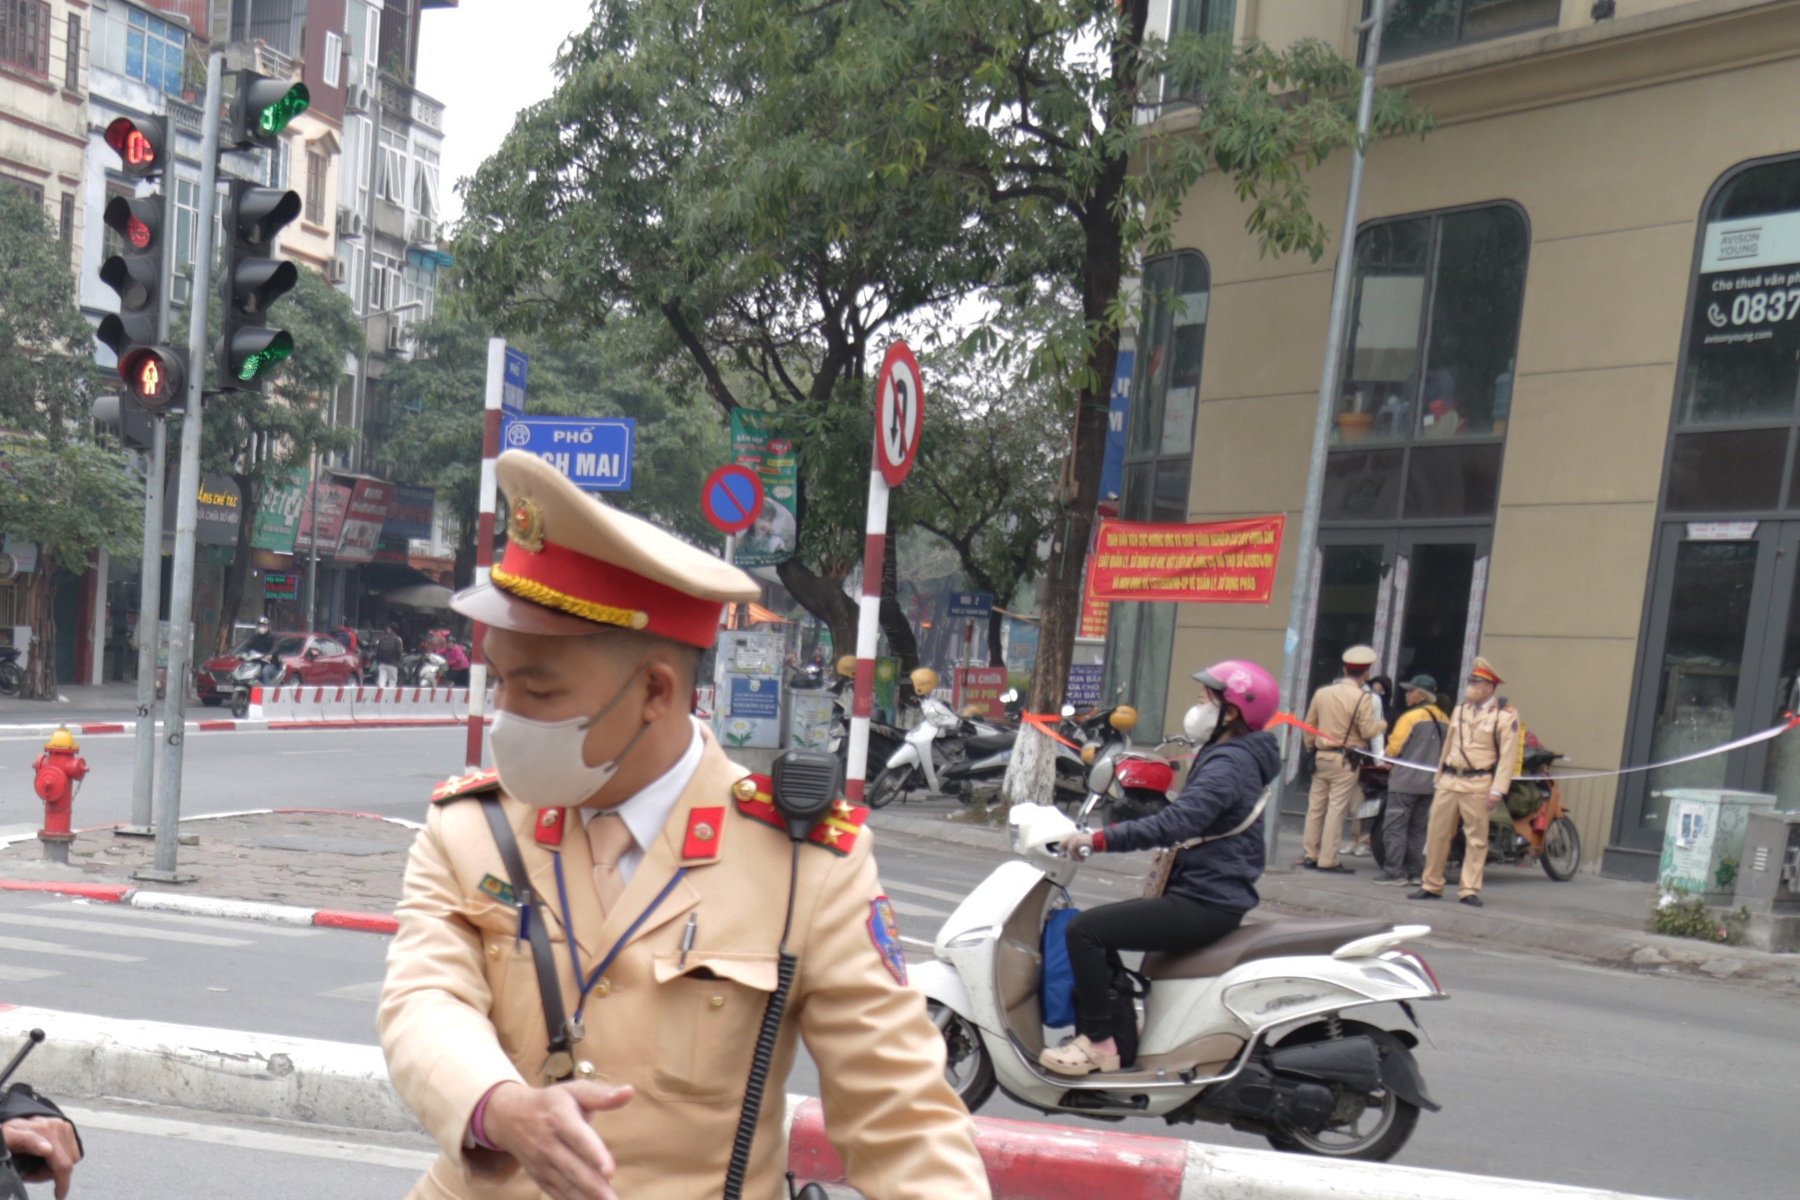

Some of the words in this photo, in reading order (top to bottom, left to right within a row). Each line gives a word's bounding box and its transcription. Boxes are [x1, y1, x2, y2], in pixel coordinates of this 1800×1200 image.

[1721, 232, 1760, 245] AVISON
[1720, 243, 1758, 256] YOUNG
[1712, 279, 1733, 292] Cho
[553, 426, 596, 444] PHỐ
[576, 453, 620, 477] MAI
